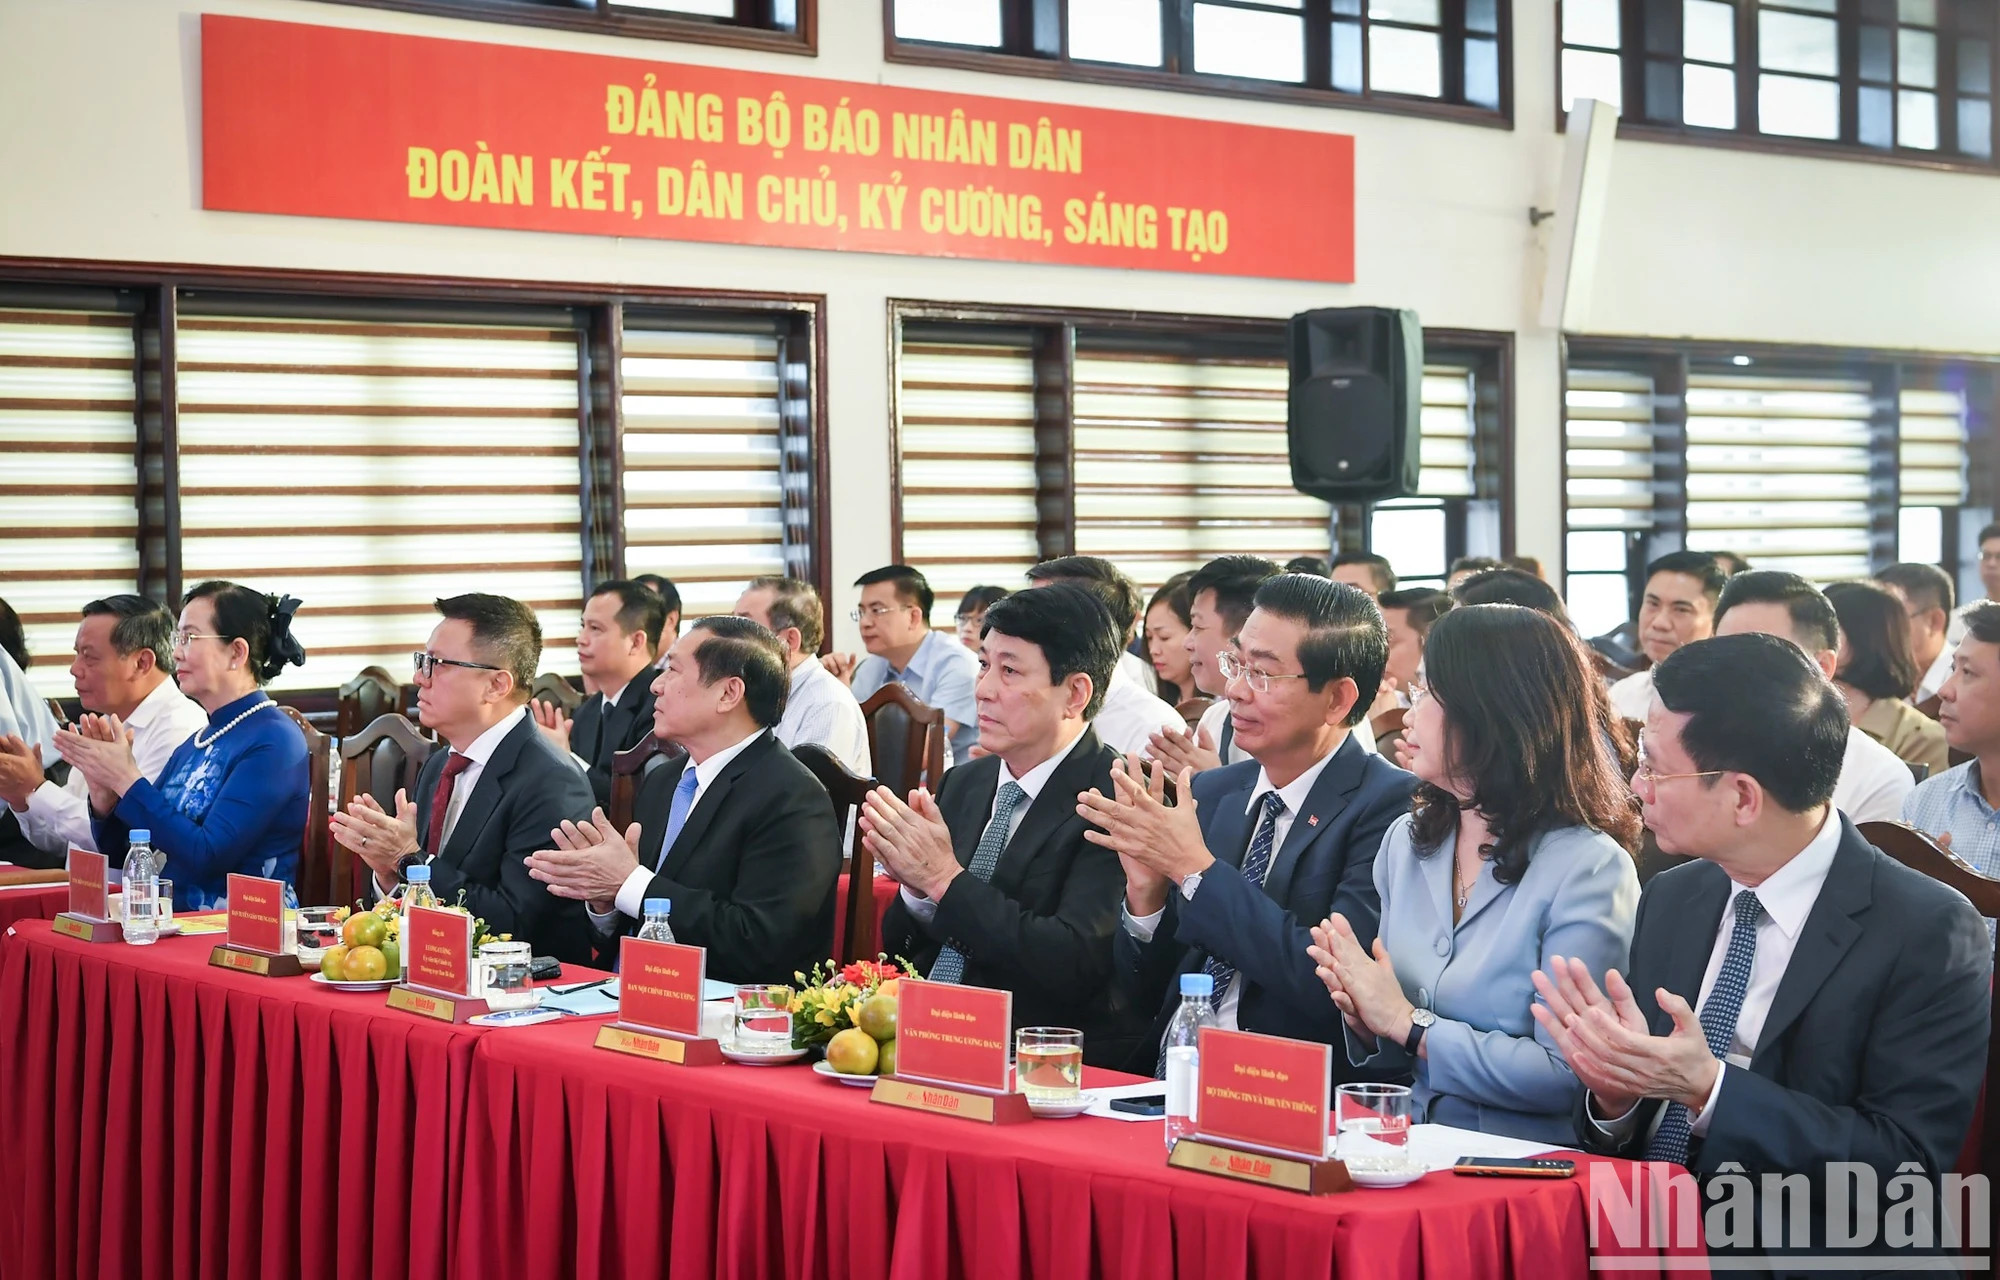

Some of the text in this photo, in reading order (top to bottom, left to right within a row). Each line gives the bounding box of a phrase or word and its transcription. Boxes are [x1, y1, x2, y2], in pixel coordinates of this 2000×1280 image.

[605, 73, 1083, 174] ĐẢNG BỘ BÁO NHÂN DÂN
[406, 140, 1229, 263] ĐOÀN KẾT, DÂN CHỦ, KỶ CƯƠNG, SÁNG TẠO
[628, 983, 637, 991] BAN
[638, 984, 647, 994] NỘI
[647, 987, 663, 996] CHÍNH
[664, 989, 680, 999] TRUNG
[930, 1008, 977, 1022] Đại diện lãnh đạo
[904, 1027, 918, 1037] VĂN
[918, 1030, 941, 1040] PHÒNG
[942, 1034, 964, 1044] TRUNG
[964, 1036, 983, 1047] ƯƠNG
[1234, 1064, 1289, 1082] Đại diện lãnh đạo
[1206, 1086, 1217, 1097] BỘ
[1217, 1087, 1241, 1100] THÔNG
[1242, 1092, 1253, 1103] TIN
[1253, 1093, 1264, 1105] VÀ
[1292, 1100, 1317, 1114] THÔNG
[1228, 1155, 1252, 1172] Nhân
[1253, 1159, 1272, 1177] Dân
